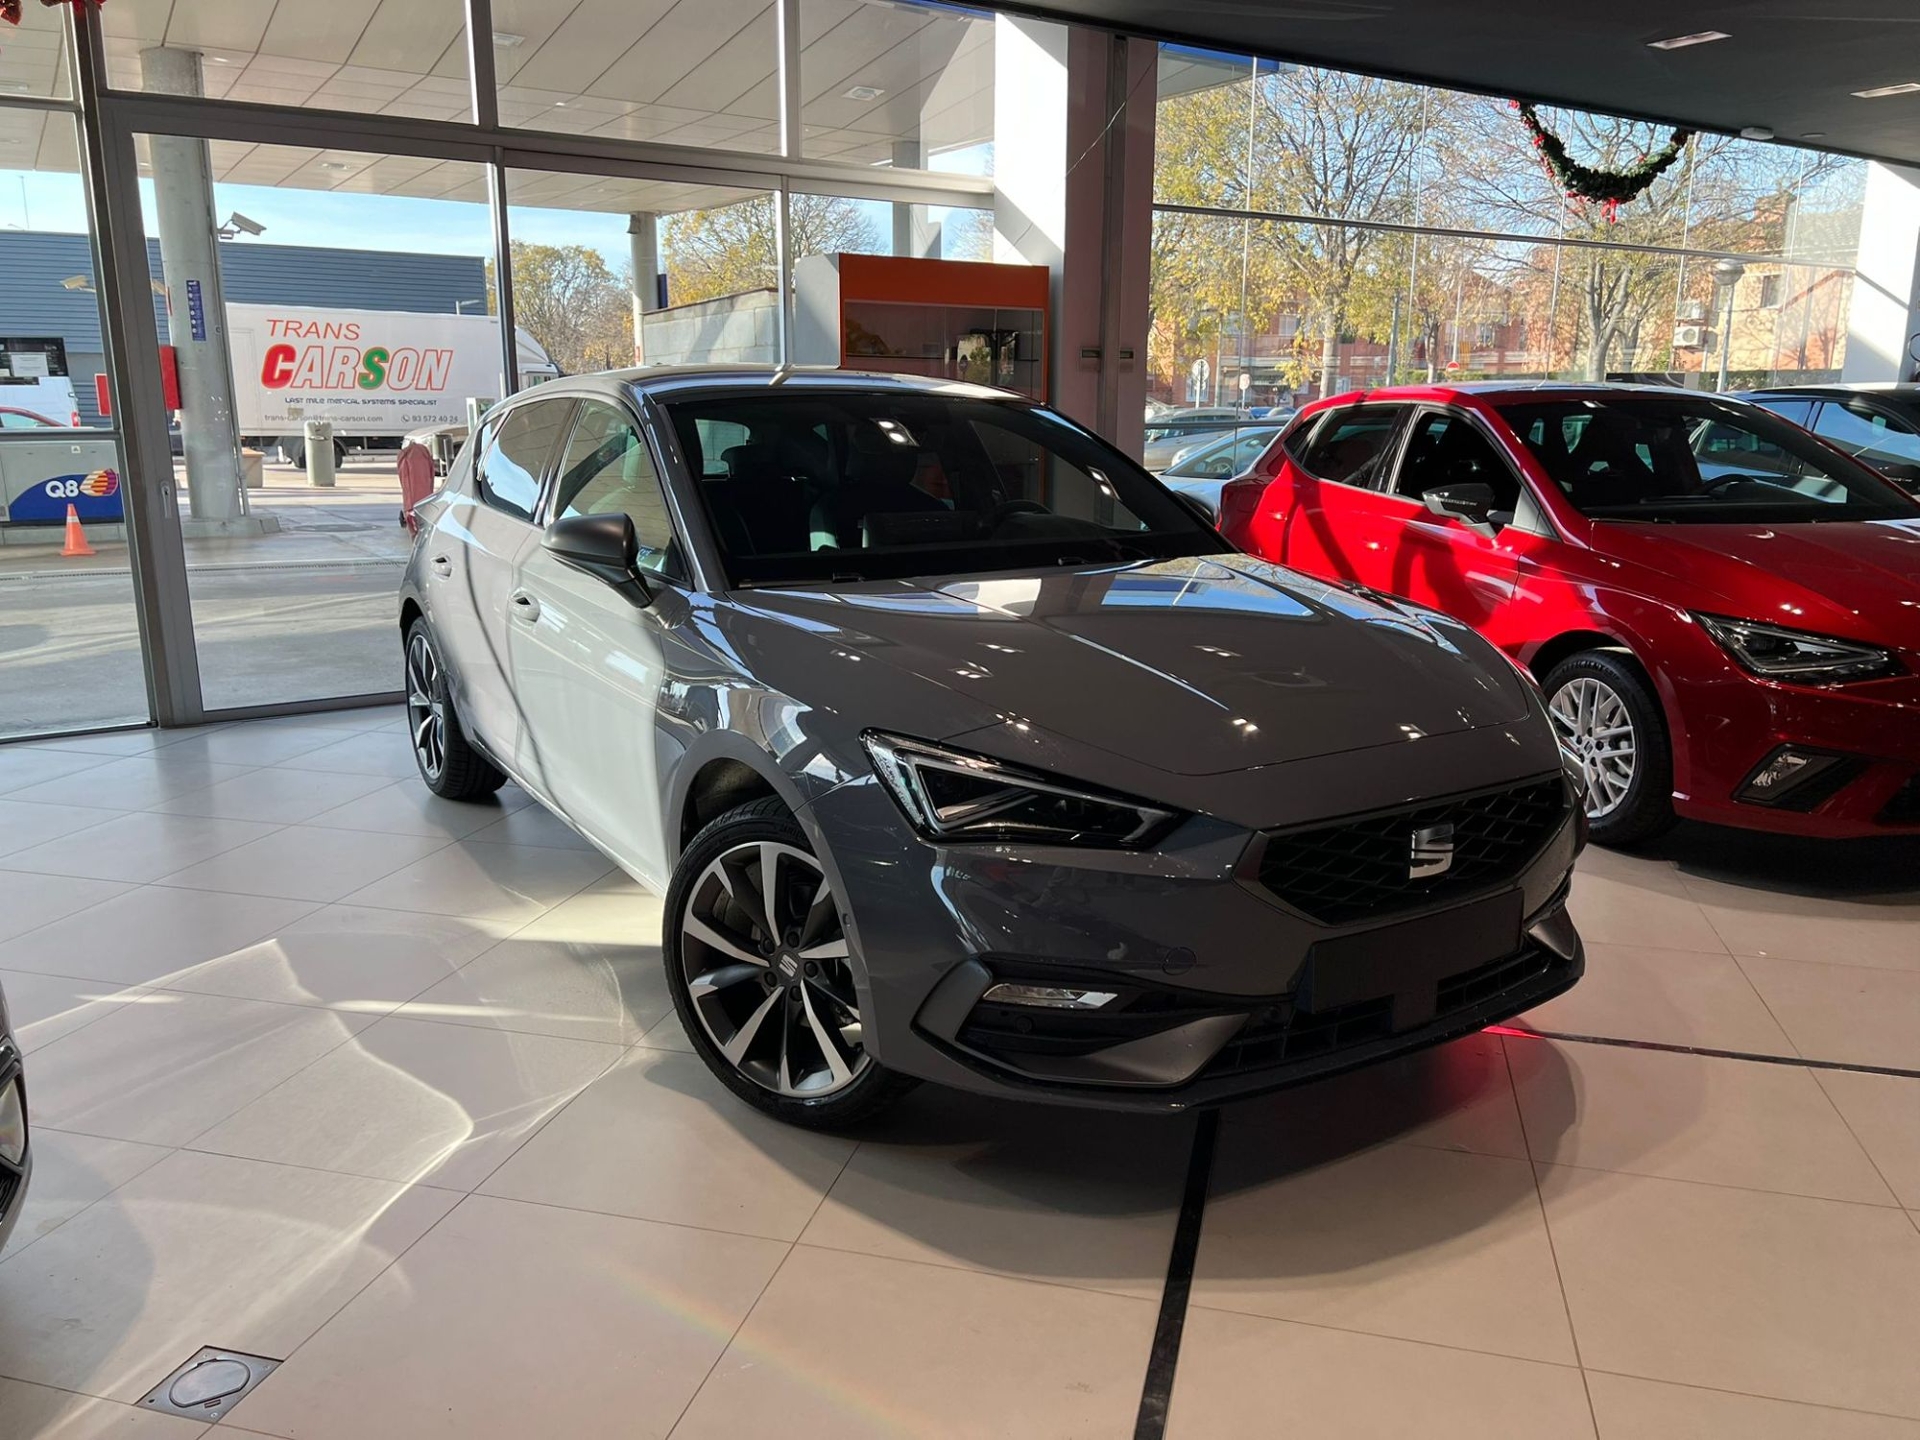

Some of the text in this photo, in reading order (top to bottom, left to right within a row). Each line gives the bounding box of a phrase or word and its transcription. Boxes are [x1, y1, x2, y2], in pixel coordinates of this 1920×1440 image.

[267, 319, 360, 341] TRANS
[261, 343, 453, 390] CARSON
[361, 398, 396, 406] SYSTEMS
[45, 480, 79, 498] Q8
